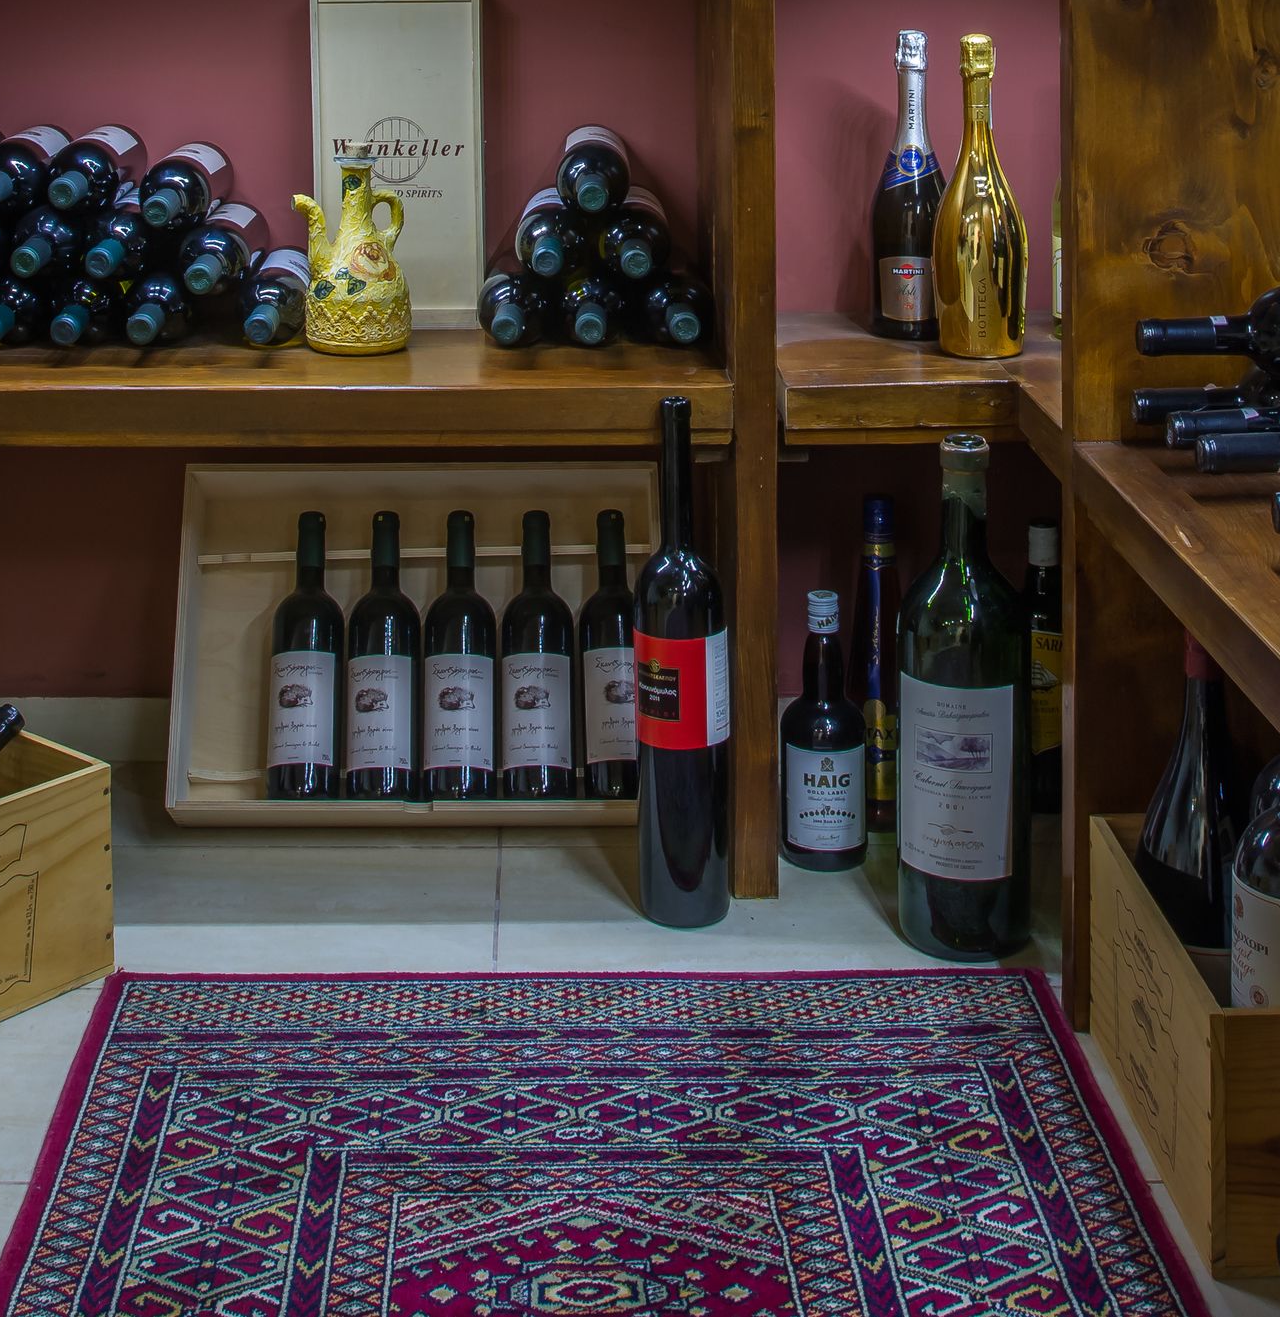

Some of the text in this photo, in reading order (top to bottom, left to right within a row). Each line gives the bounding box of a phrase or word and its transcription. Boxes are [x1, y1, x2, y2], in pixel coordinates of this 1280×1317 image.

[908, 88, 916, 130] MARTINI
[332, 138, 465, 157] Winkeller
[405, 190, 443, 199] SPIRITS
[892, 267, 924, 276] MARTINI
[978, 277, 987, 338] BOTTEGA
[936, 701, 967, 710] DOMAINE
[803, 772, 851, 788] HAIG
[912, 768, 992, 796] Cabernet Sauvignon
